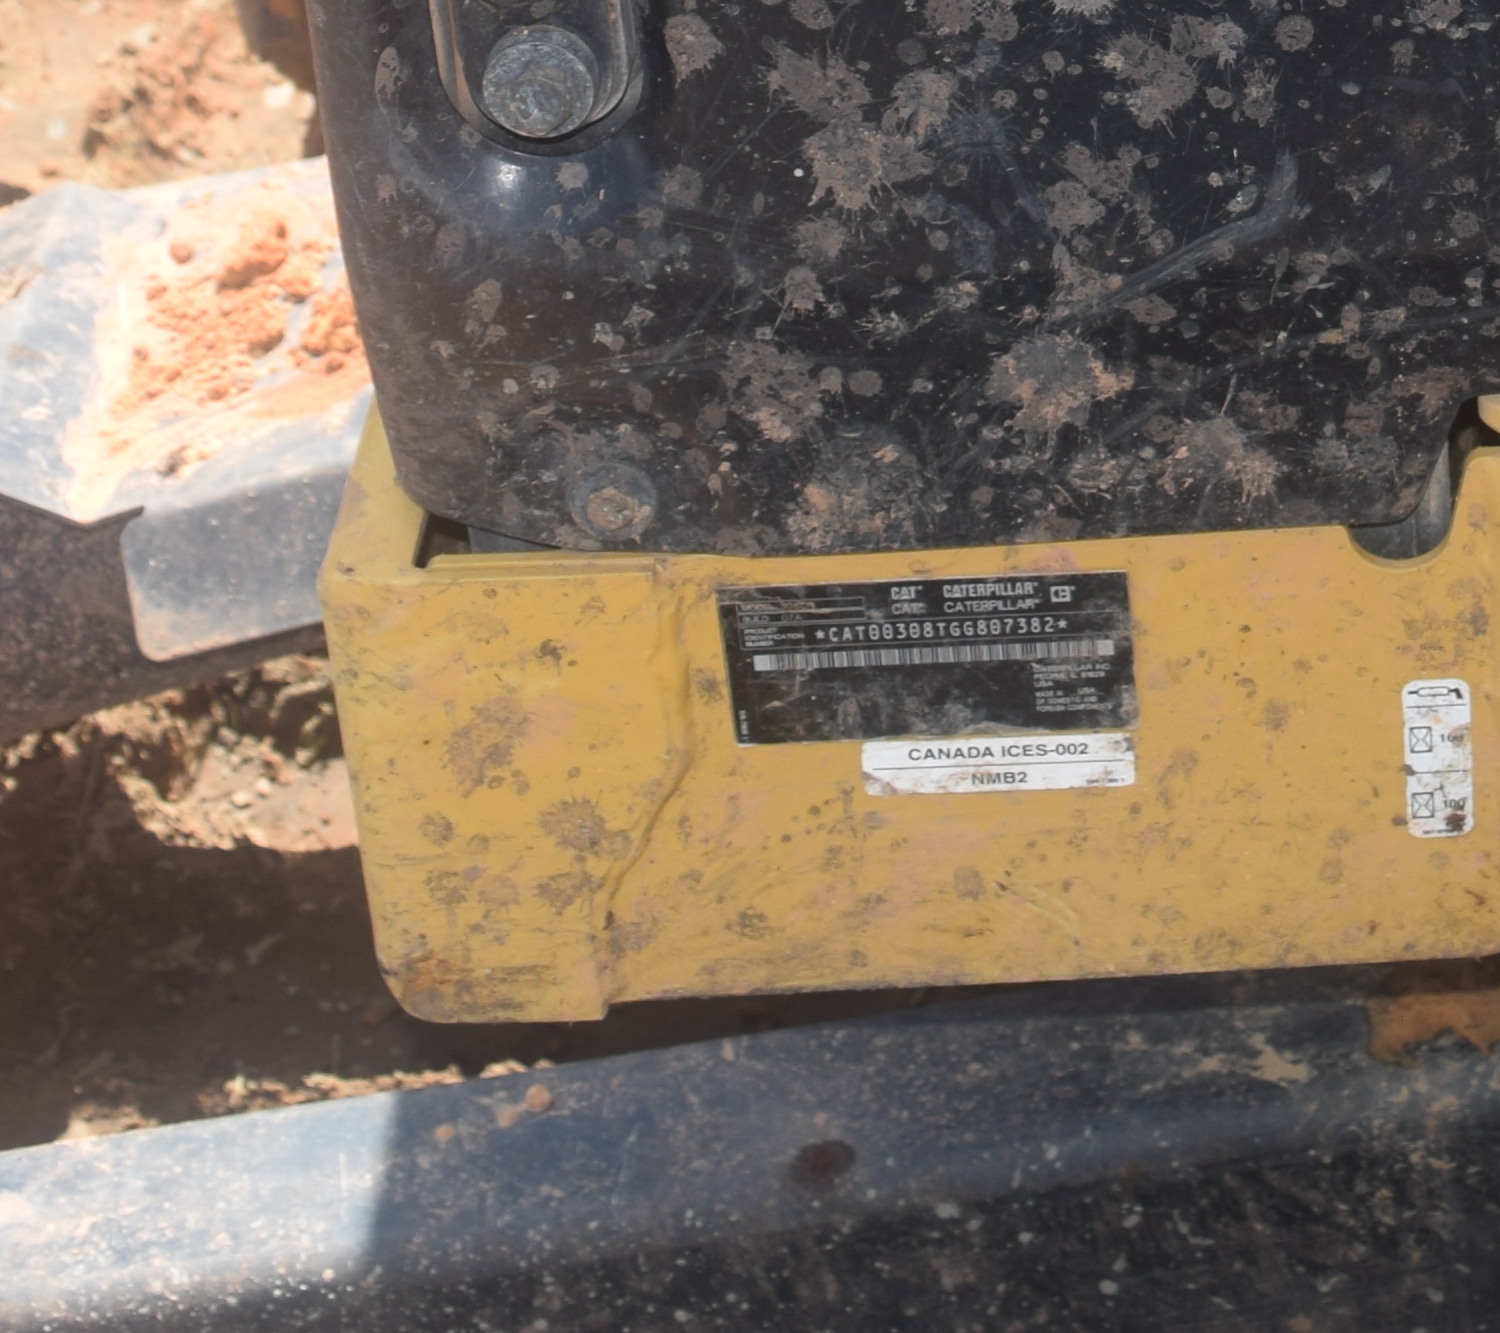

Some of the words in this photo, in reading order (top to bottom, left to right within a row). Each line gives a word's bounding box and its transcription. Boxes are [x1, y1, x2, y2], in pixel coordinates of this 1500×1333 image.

[890, 585, 917, 600] CAT
[943, 581, 1035, 598] CATERPILLAR
[943, 598, 1036, 613] CATERPILLAR
[908, 745, 995, 761] CANADA
[1001, 742, 1089, 758] ICES-002
[971, 771, 1028, 785] NMB2
